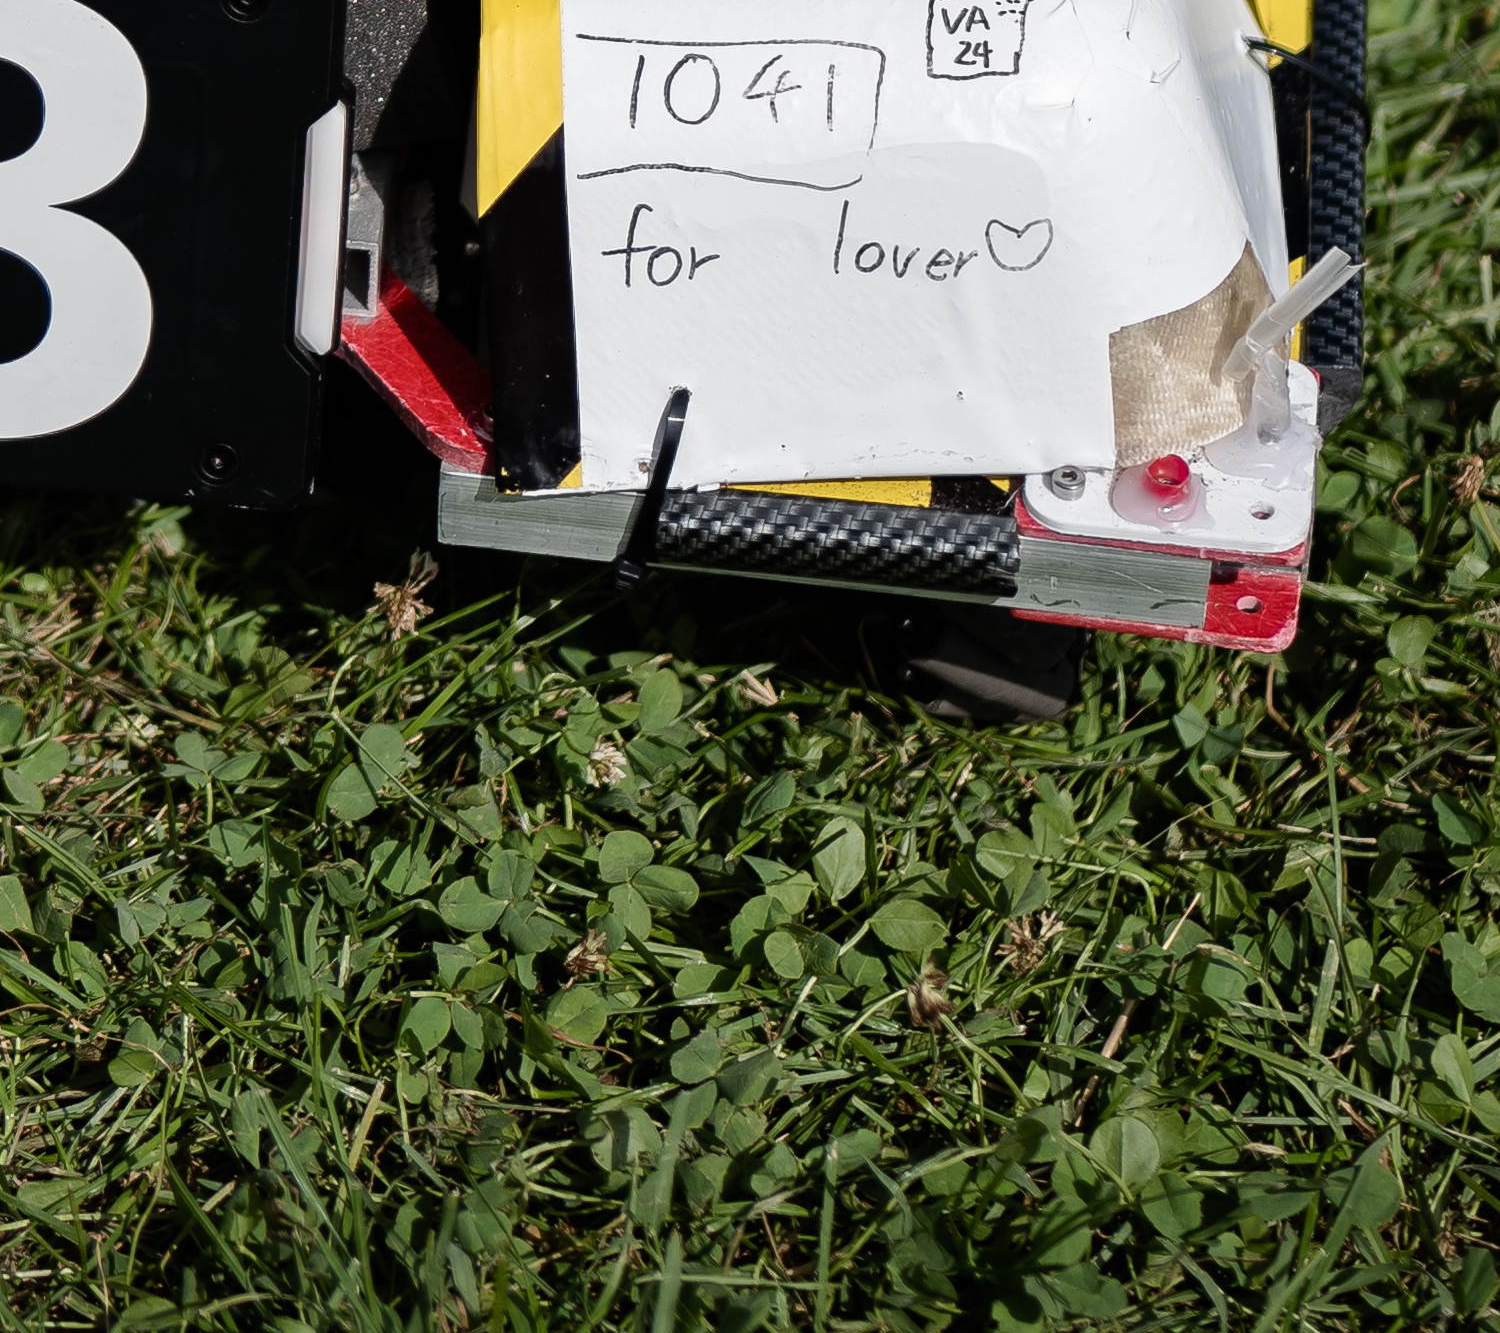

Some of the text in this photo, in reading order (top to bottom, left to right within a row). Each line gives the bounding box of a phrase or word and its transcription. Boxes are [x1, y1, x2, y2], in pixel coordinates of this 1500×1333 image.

[940, 6, 991, 34] VA
[951, 39, 993, 69] 24
[627, 52, 837, 132] 1041
[601, 199, 980, 288] for lover
